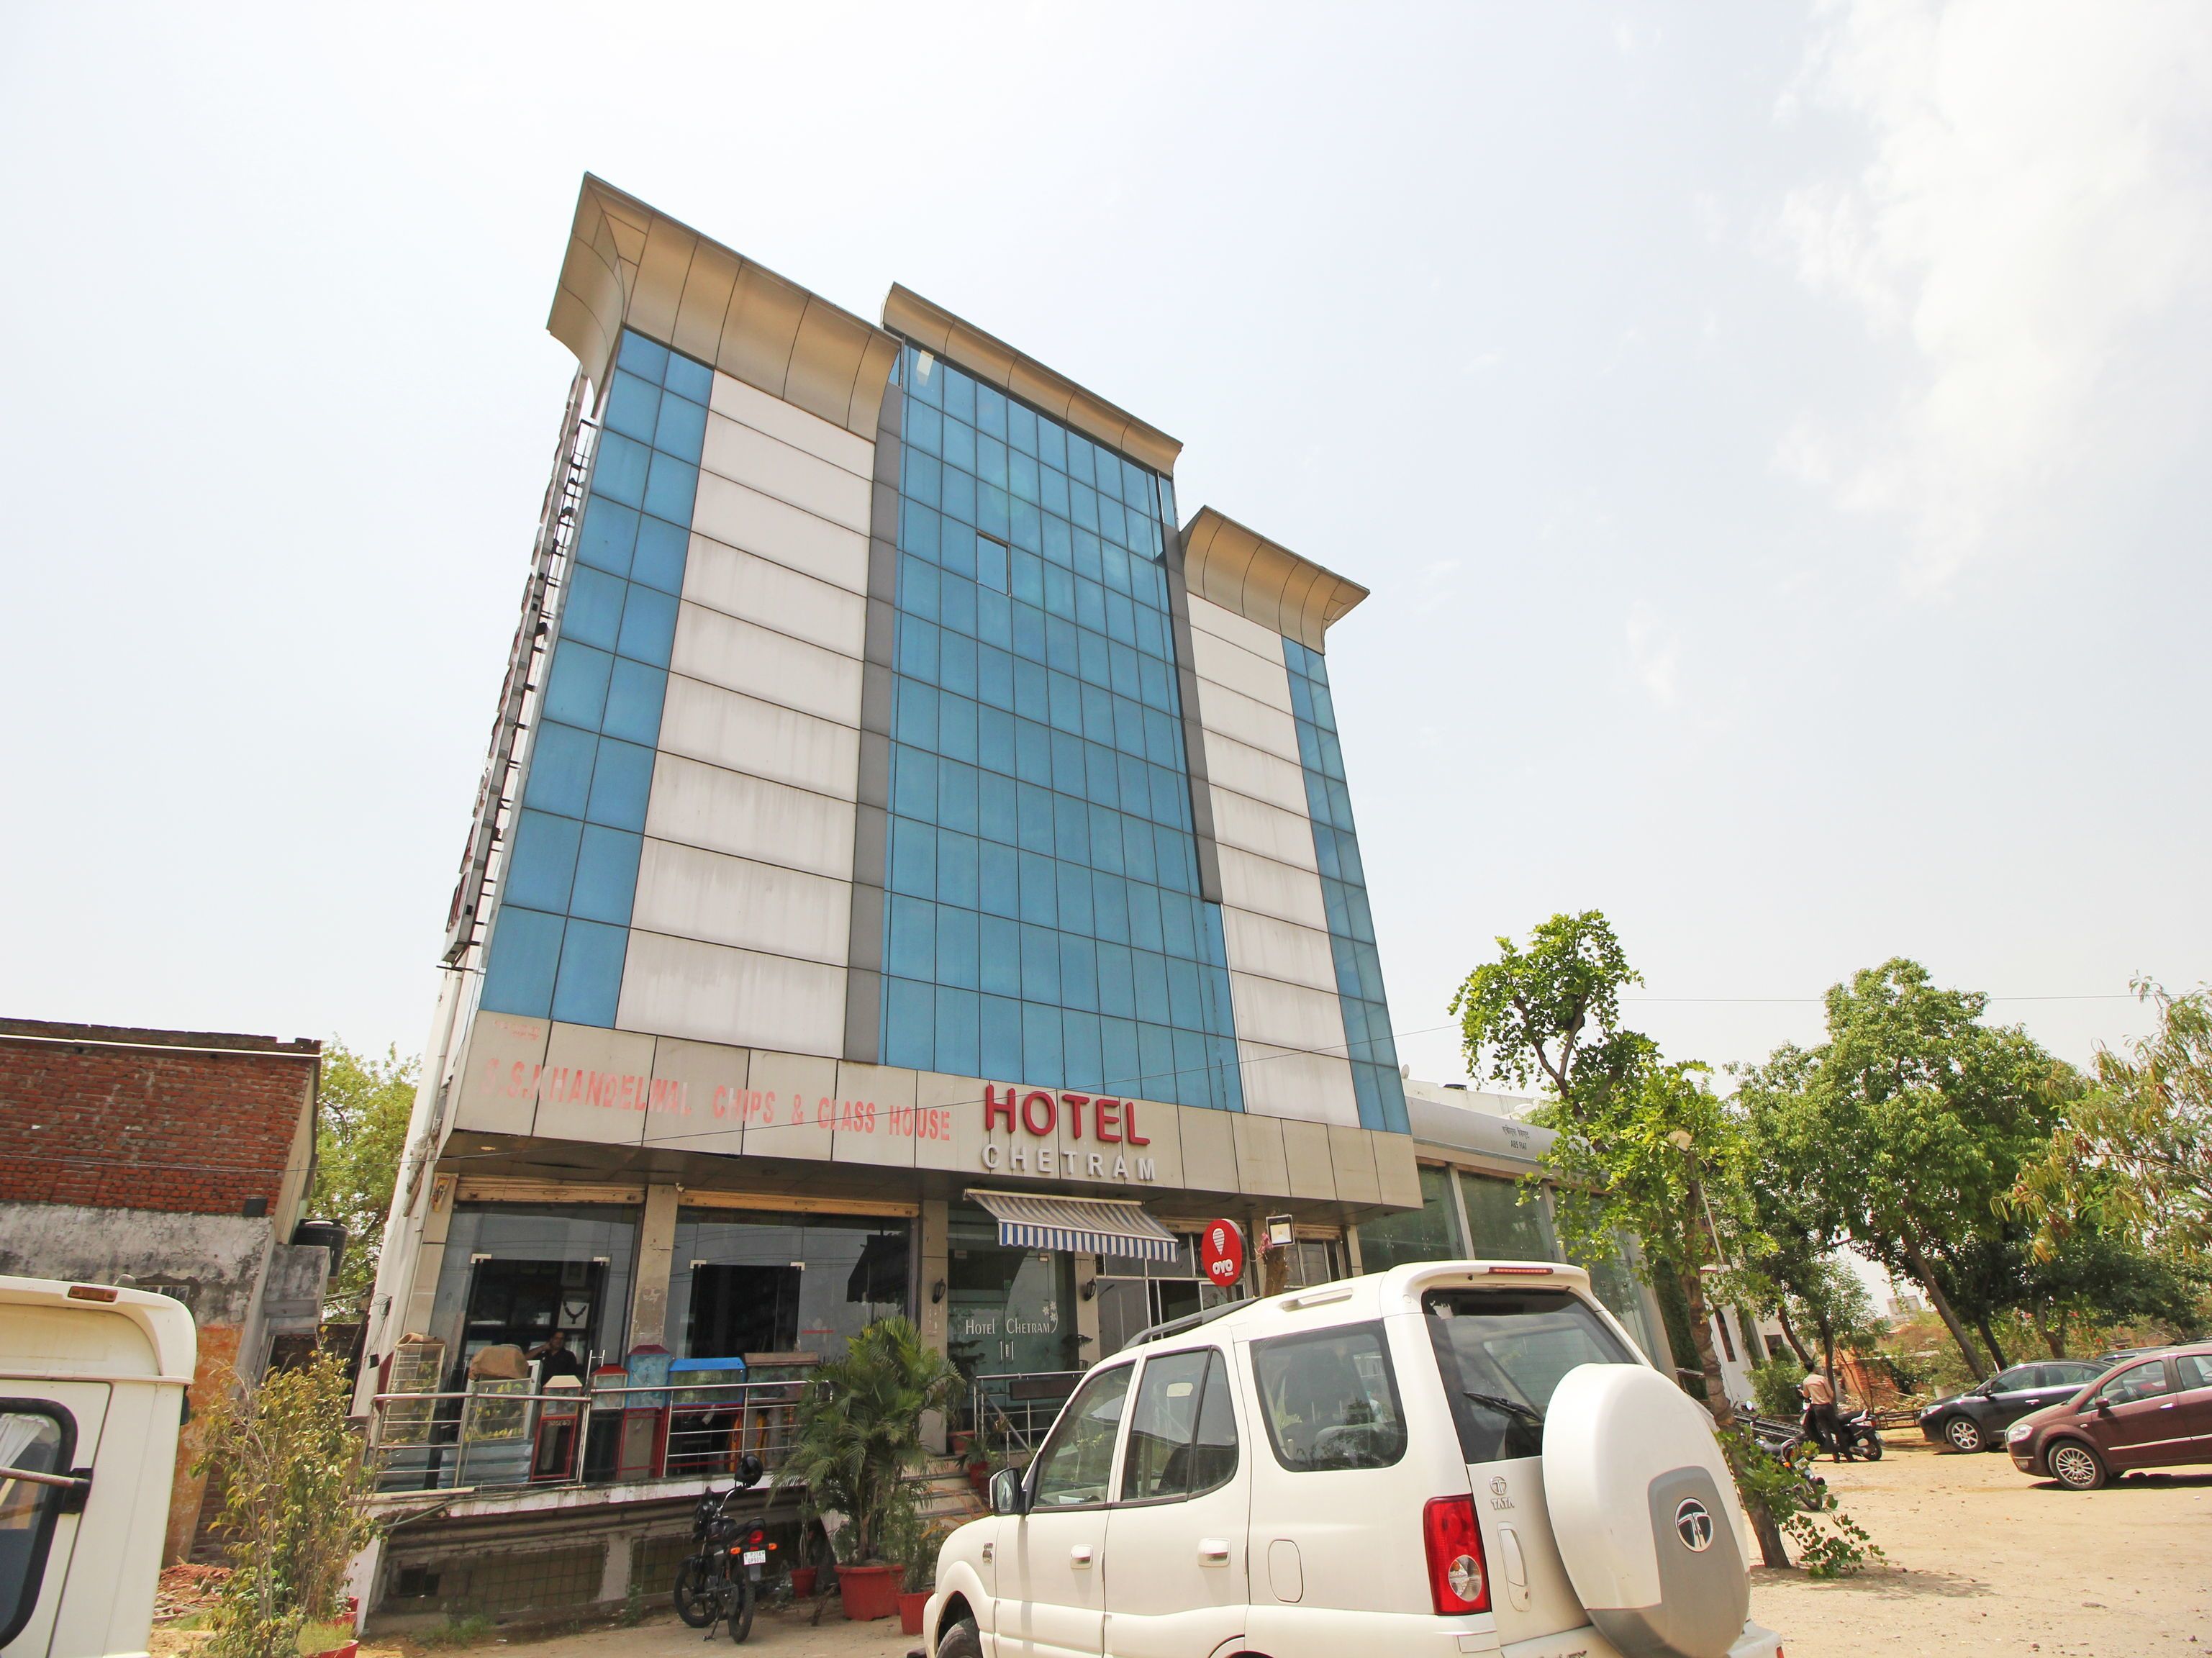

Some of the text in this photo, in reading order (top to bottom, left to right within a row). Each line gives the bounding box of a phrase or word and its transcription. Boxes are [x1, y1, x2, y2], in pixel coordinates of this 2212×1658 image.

[712, 1084, 776, 1124] CHIPS
[792, 1093, 804, 1125] &
[889, 1105, 950, 1141] HOUSE
[985, 1084, 1151, 1146] HOTEL
[982, 1143, 1156, 1181] CHETRAM
[1212, 1259, 1233, 1274] OYO
[1490, 1497, 1515, 1510] TATA
